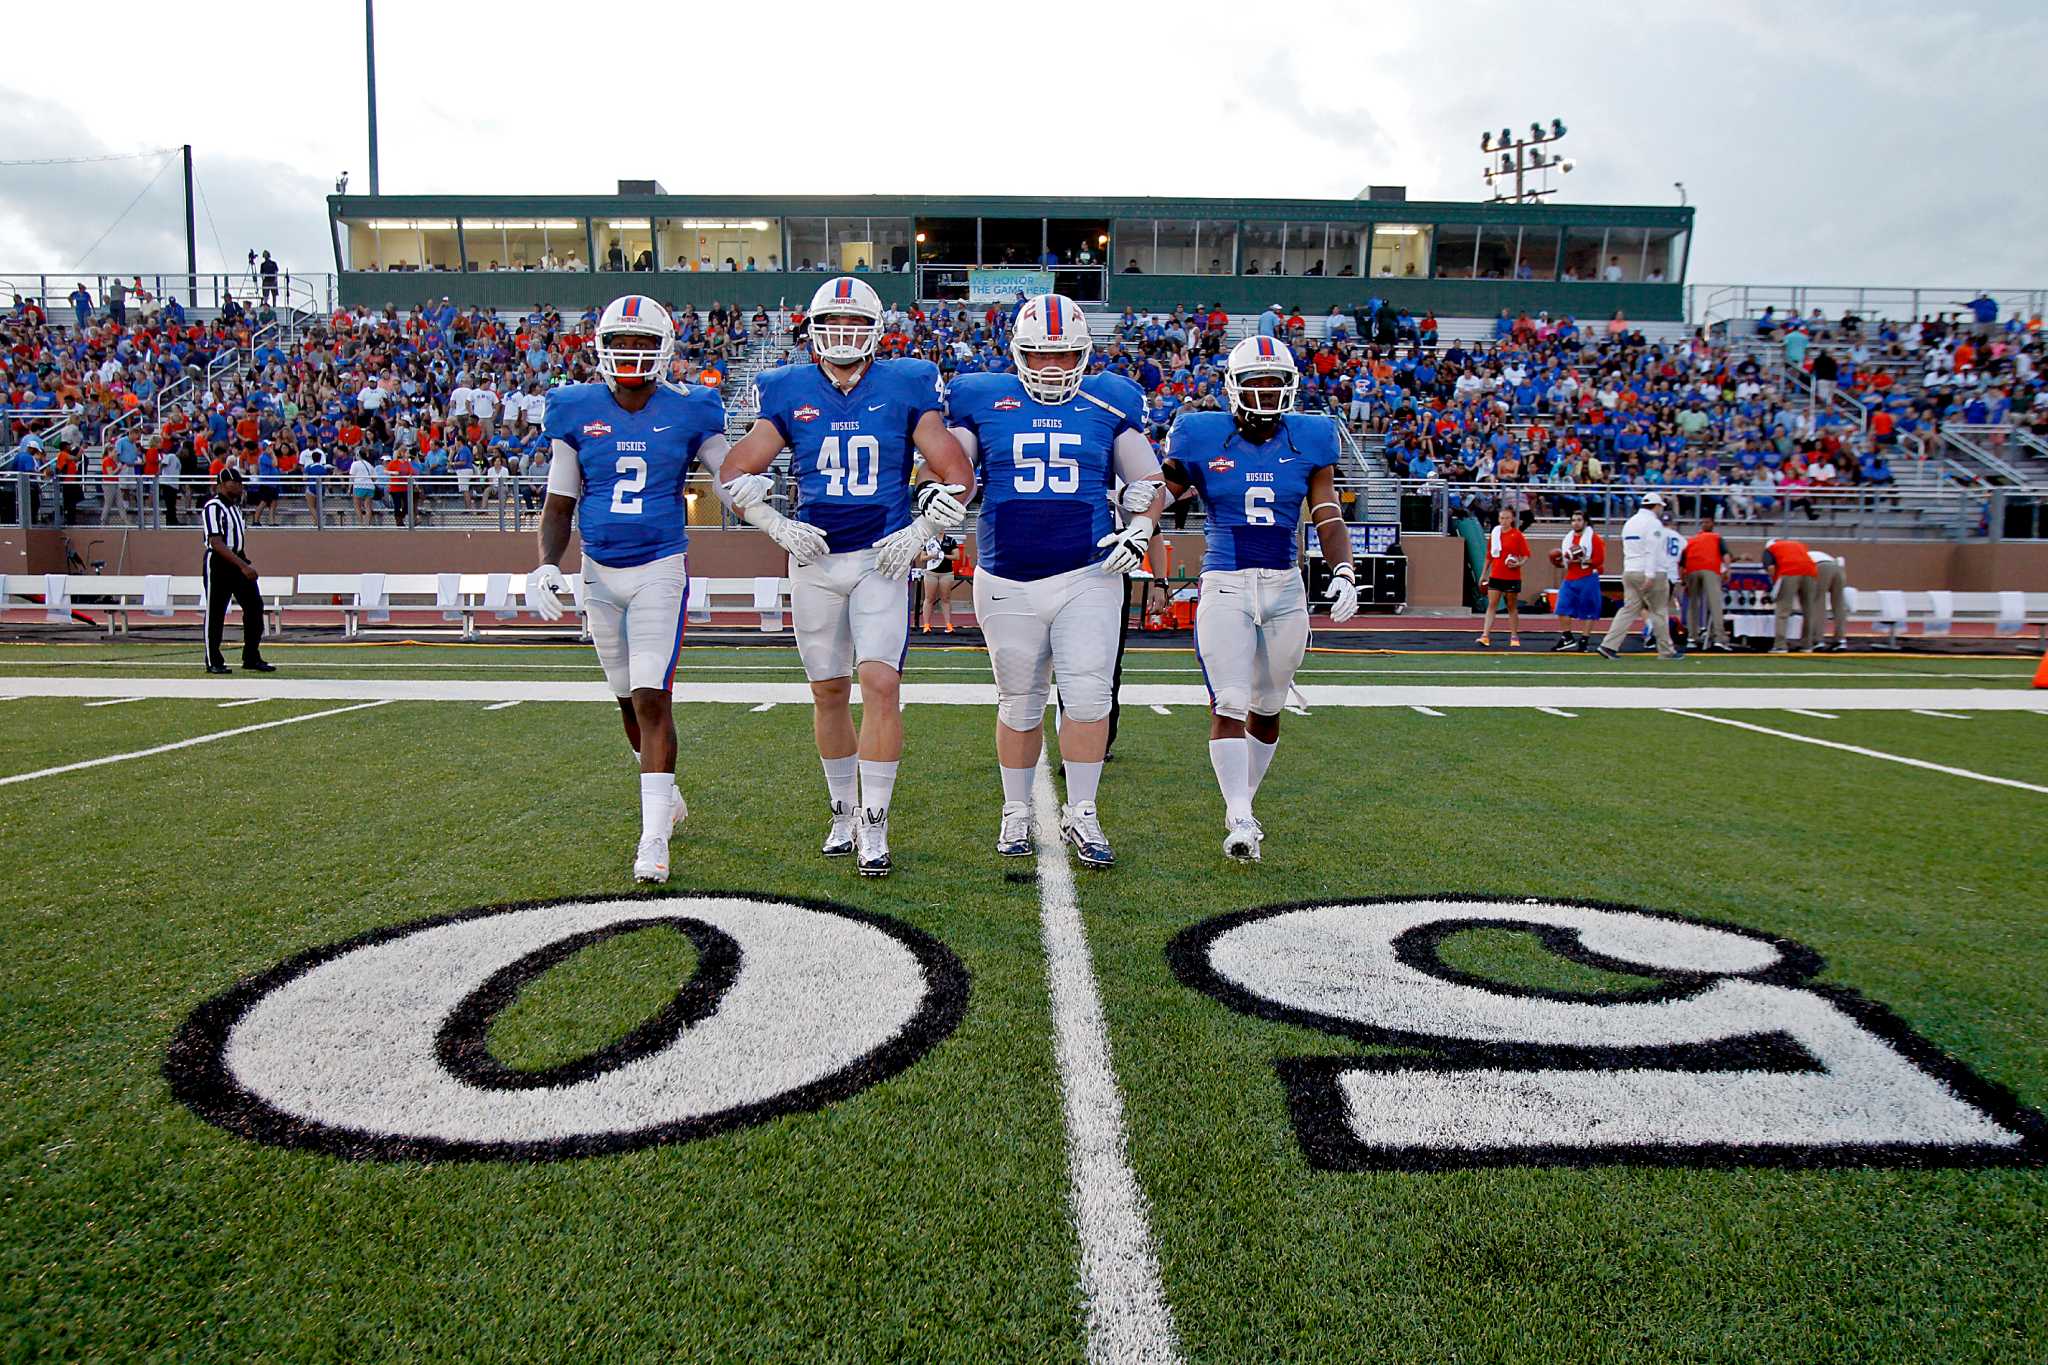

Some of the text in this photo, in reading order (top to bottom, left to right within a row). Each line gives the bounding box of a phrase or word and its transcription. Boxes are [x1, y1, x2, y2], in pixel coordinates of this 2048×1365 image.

[993, 276, 1034, 285] HONOR
[973, 285, 1052, 295] THE GAME HERE
[831, 421, 860, 431] HUSKIES
[1032, 419, 1063, 429] HUSKIES
[616, 441, 647, 452] HUSKIES
[816, 435, 879, 497] 40
[1013, 432, 1082, 494] 55
[1245, 472, 1274, 482] HUSKIES
[610, 456, 648, 514] 2
[1244, 486, 1276, 526] 6
